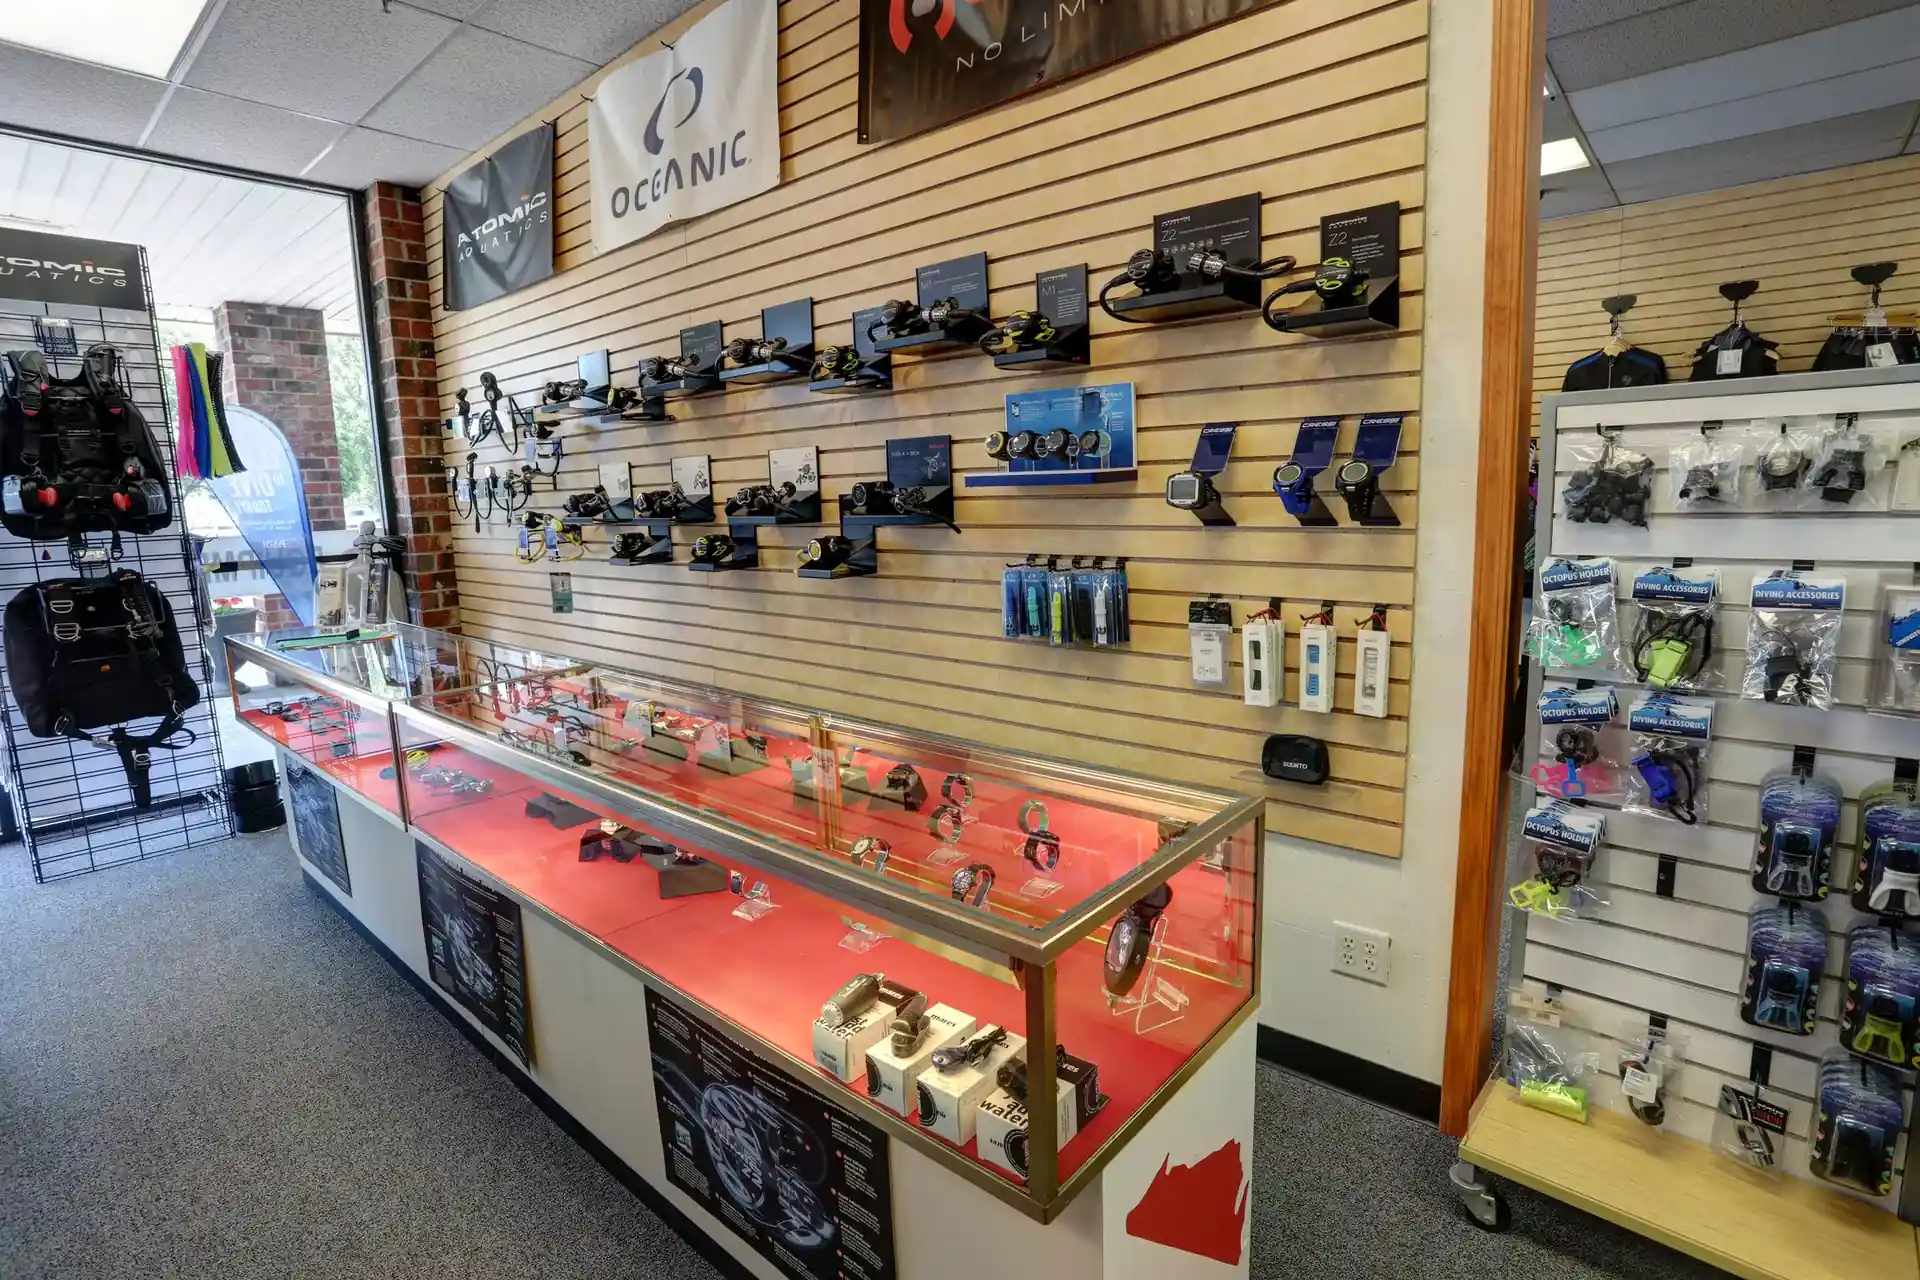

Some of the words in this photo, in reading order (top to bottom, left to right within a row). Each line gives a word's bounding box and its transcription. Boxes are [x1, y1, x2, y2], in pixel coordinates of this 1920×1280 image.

[956, 42, 1002, 73] NO
[1021, 0, 1103, 43] LIM
[611, 129, 747, 219] OCEANIC
[458, 210, 548, 263] AQUATICS
[1161, 229, 1178, 243] Z2
[1328, 231, 1348, 247] Z2
[1301, 420, 1338, 428] CRESSI
[1362, 417, 1400, 425] CRESSI
[1543, 572, 1578, 584] OCTOPUS
[1580, 567, 1610, 579] HOLDER
[1636, 582, 1661, 591] DIVING
[1662, 584, 1709, 594] ACCESSORIES
[1755, 590, 1784, 598] DIVING
[1786, 591, 1840, 600] ACCESSORIES
[1542, 708, 1576, 718] OCTOPUS
[1578, 706, 1608, 716] HOLDER
[1632, 715, 1658, 724] DIVING
[1659, 718, 1706, 729] ACCESSORIES
[1526, 821, 1560, 837] OCTOPUS
[1560, 830, 1591, 845] HOLDER
[930, 1013, 957, 1028] mares
